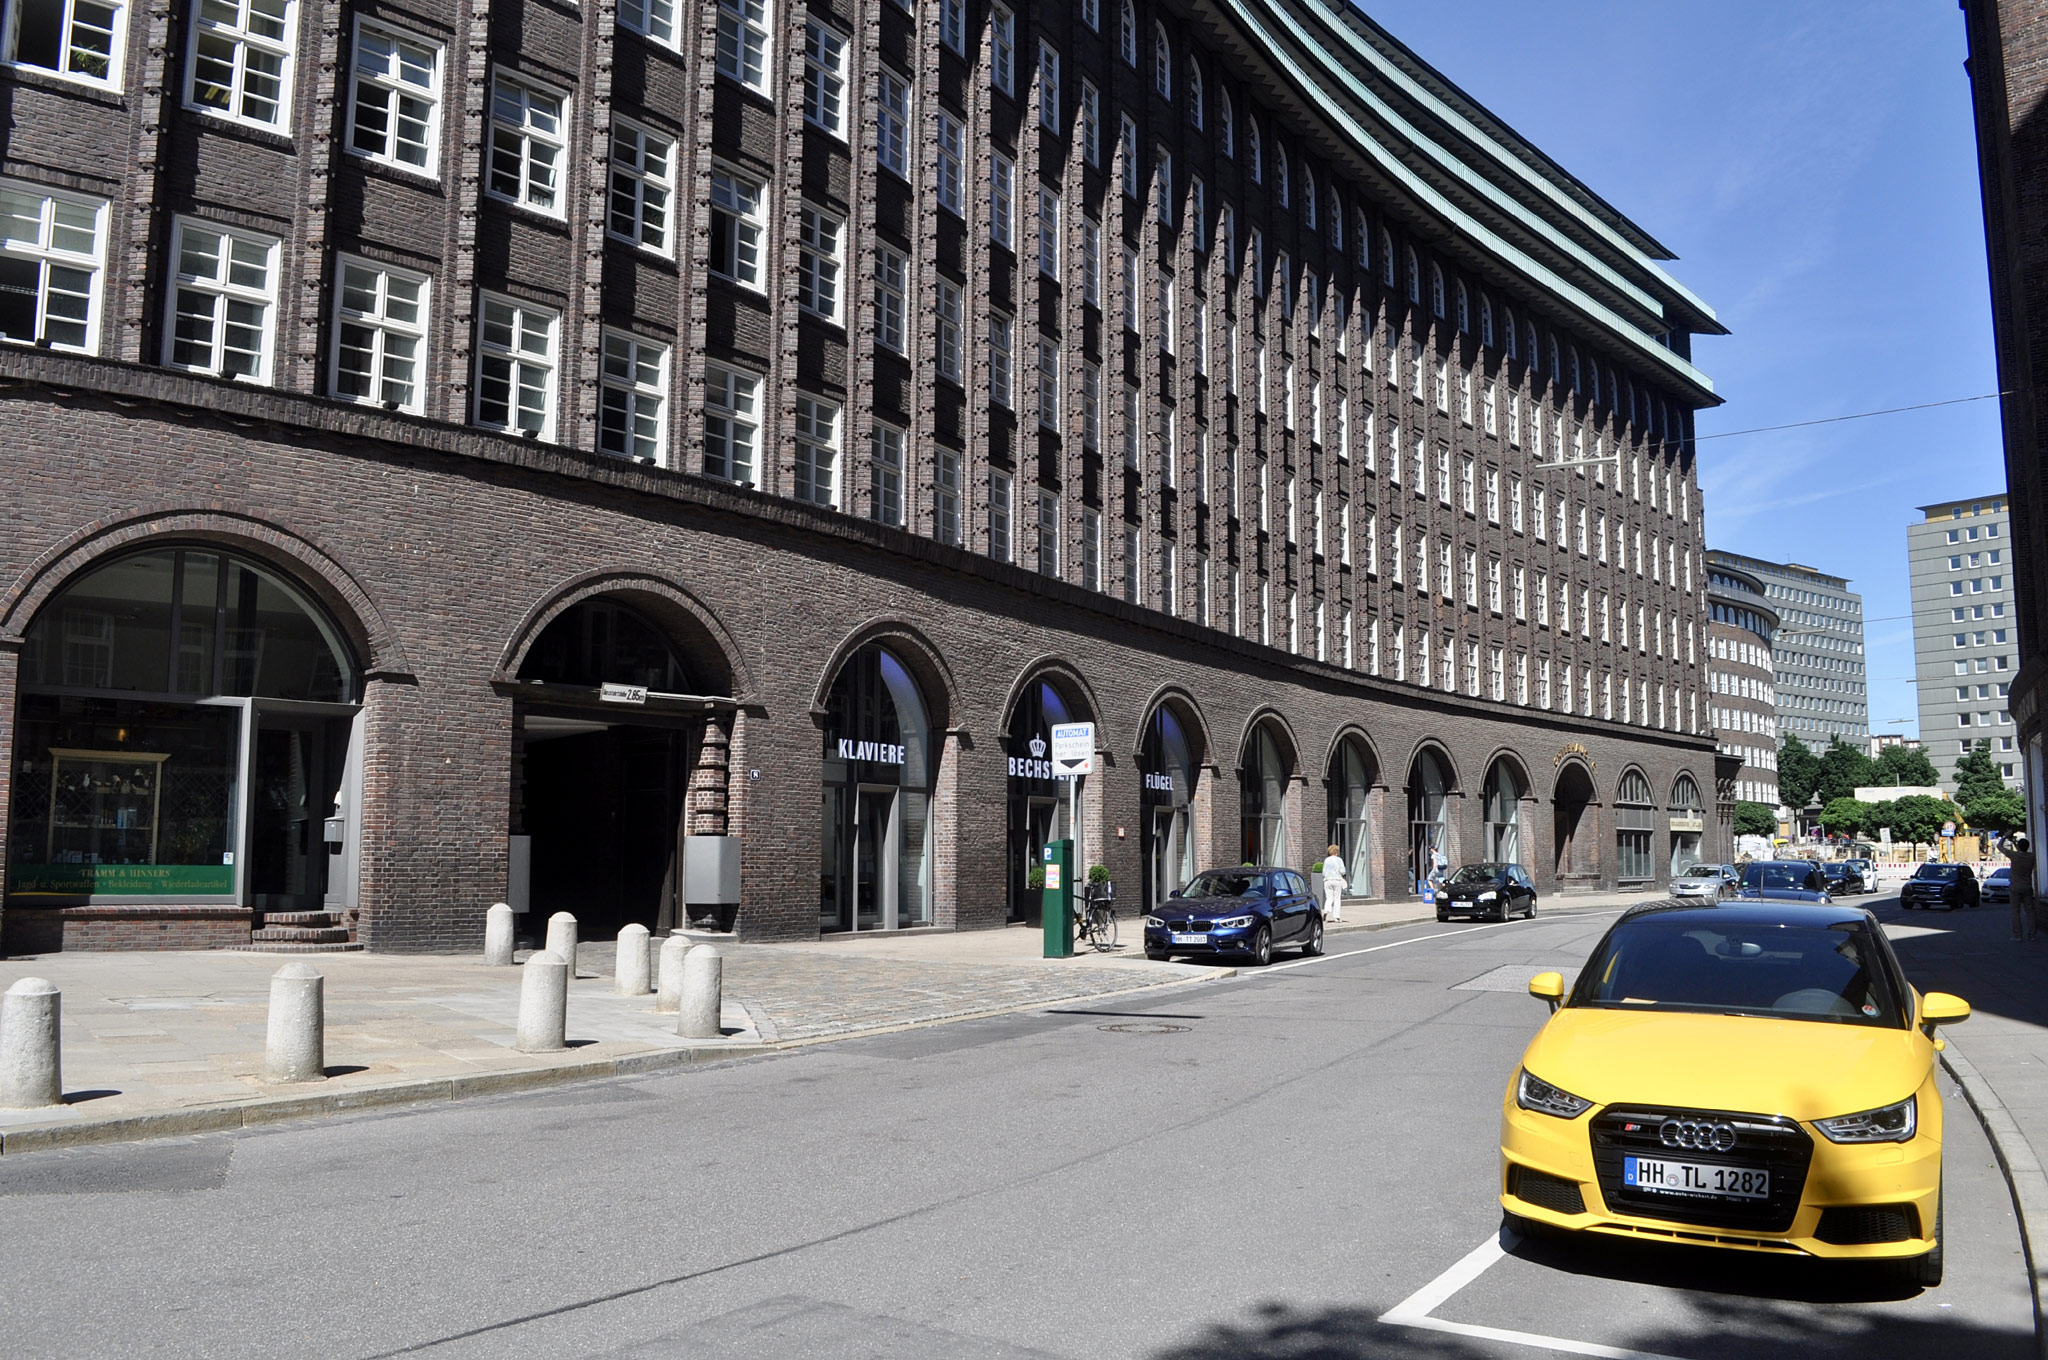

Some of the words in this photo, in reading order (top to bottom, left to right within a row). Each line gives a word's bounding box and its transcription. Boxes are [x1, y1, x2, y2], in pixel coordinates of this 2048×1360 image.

[1056, 728, 1088, 738] AUTOMAT
[1055, 742, 1090, 750] Parkschein
[838, 738, 905, 765] KLAVIERE
[1008, 757, 1079, 782] BECHS
[1145, 771, 1174, 791] FLÜGEL
[81, 869, 115, 877] TRAMM
[119, 869, 126, 877] &
[130, 869, 171, 878] HINNERS
[50, 880, 99, 890] Sportwaffen
[108, 881, 152, 889] Bekleidung
[161, 881, 227, 889] Wiederladeartikel
[1627, 1173, 1634, 1181] D
[1639, 1161, 1664, 1184] HH
[1681, 1166, 1706, 1189] TL
[1714, 1169, 1767, 1195] 1282
